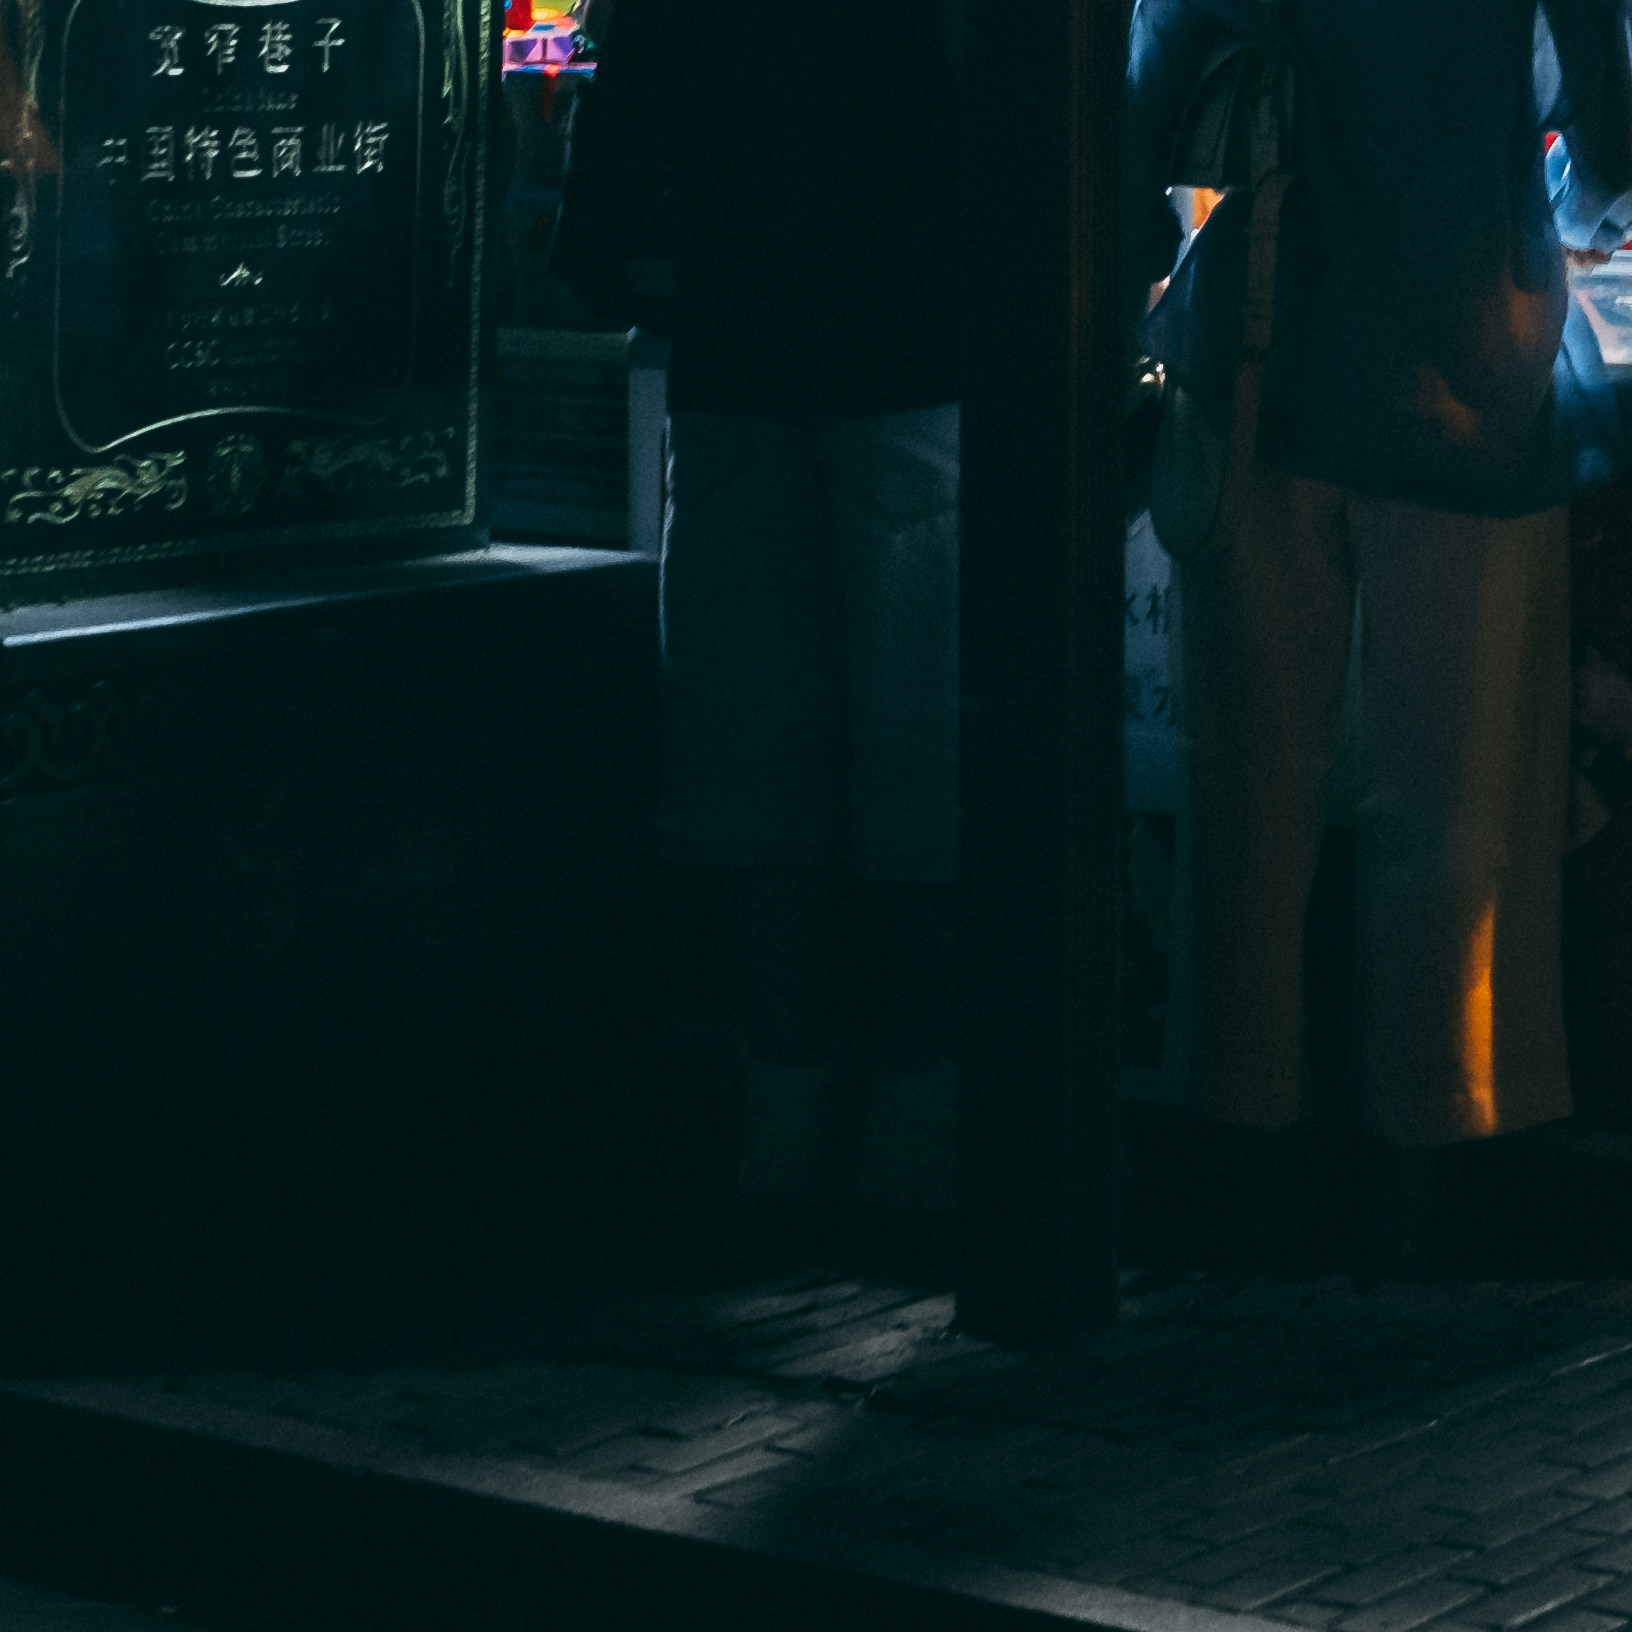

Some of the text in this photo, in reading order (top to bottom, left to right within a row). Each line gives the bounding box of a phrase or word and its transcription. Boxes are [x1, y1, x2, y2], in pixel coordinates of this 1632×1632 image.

[147, 17, 347, 77] 宽窄巷子
[97, 120, 390, 186] 中国特色商业街
